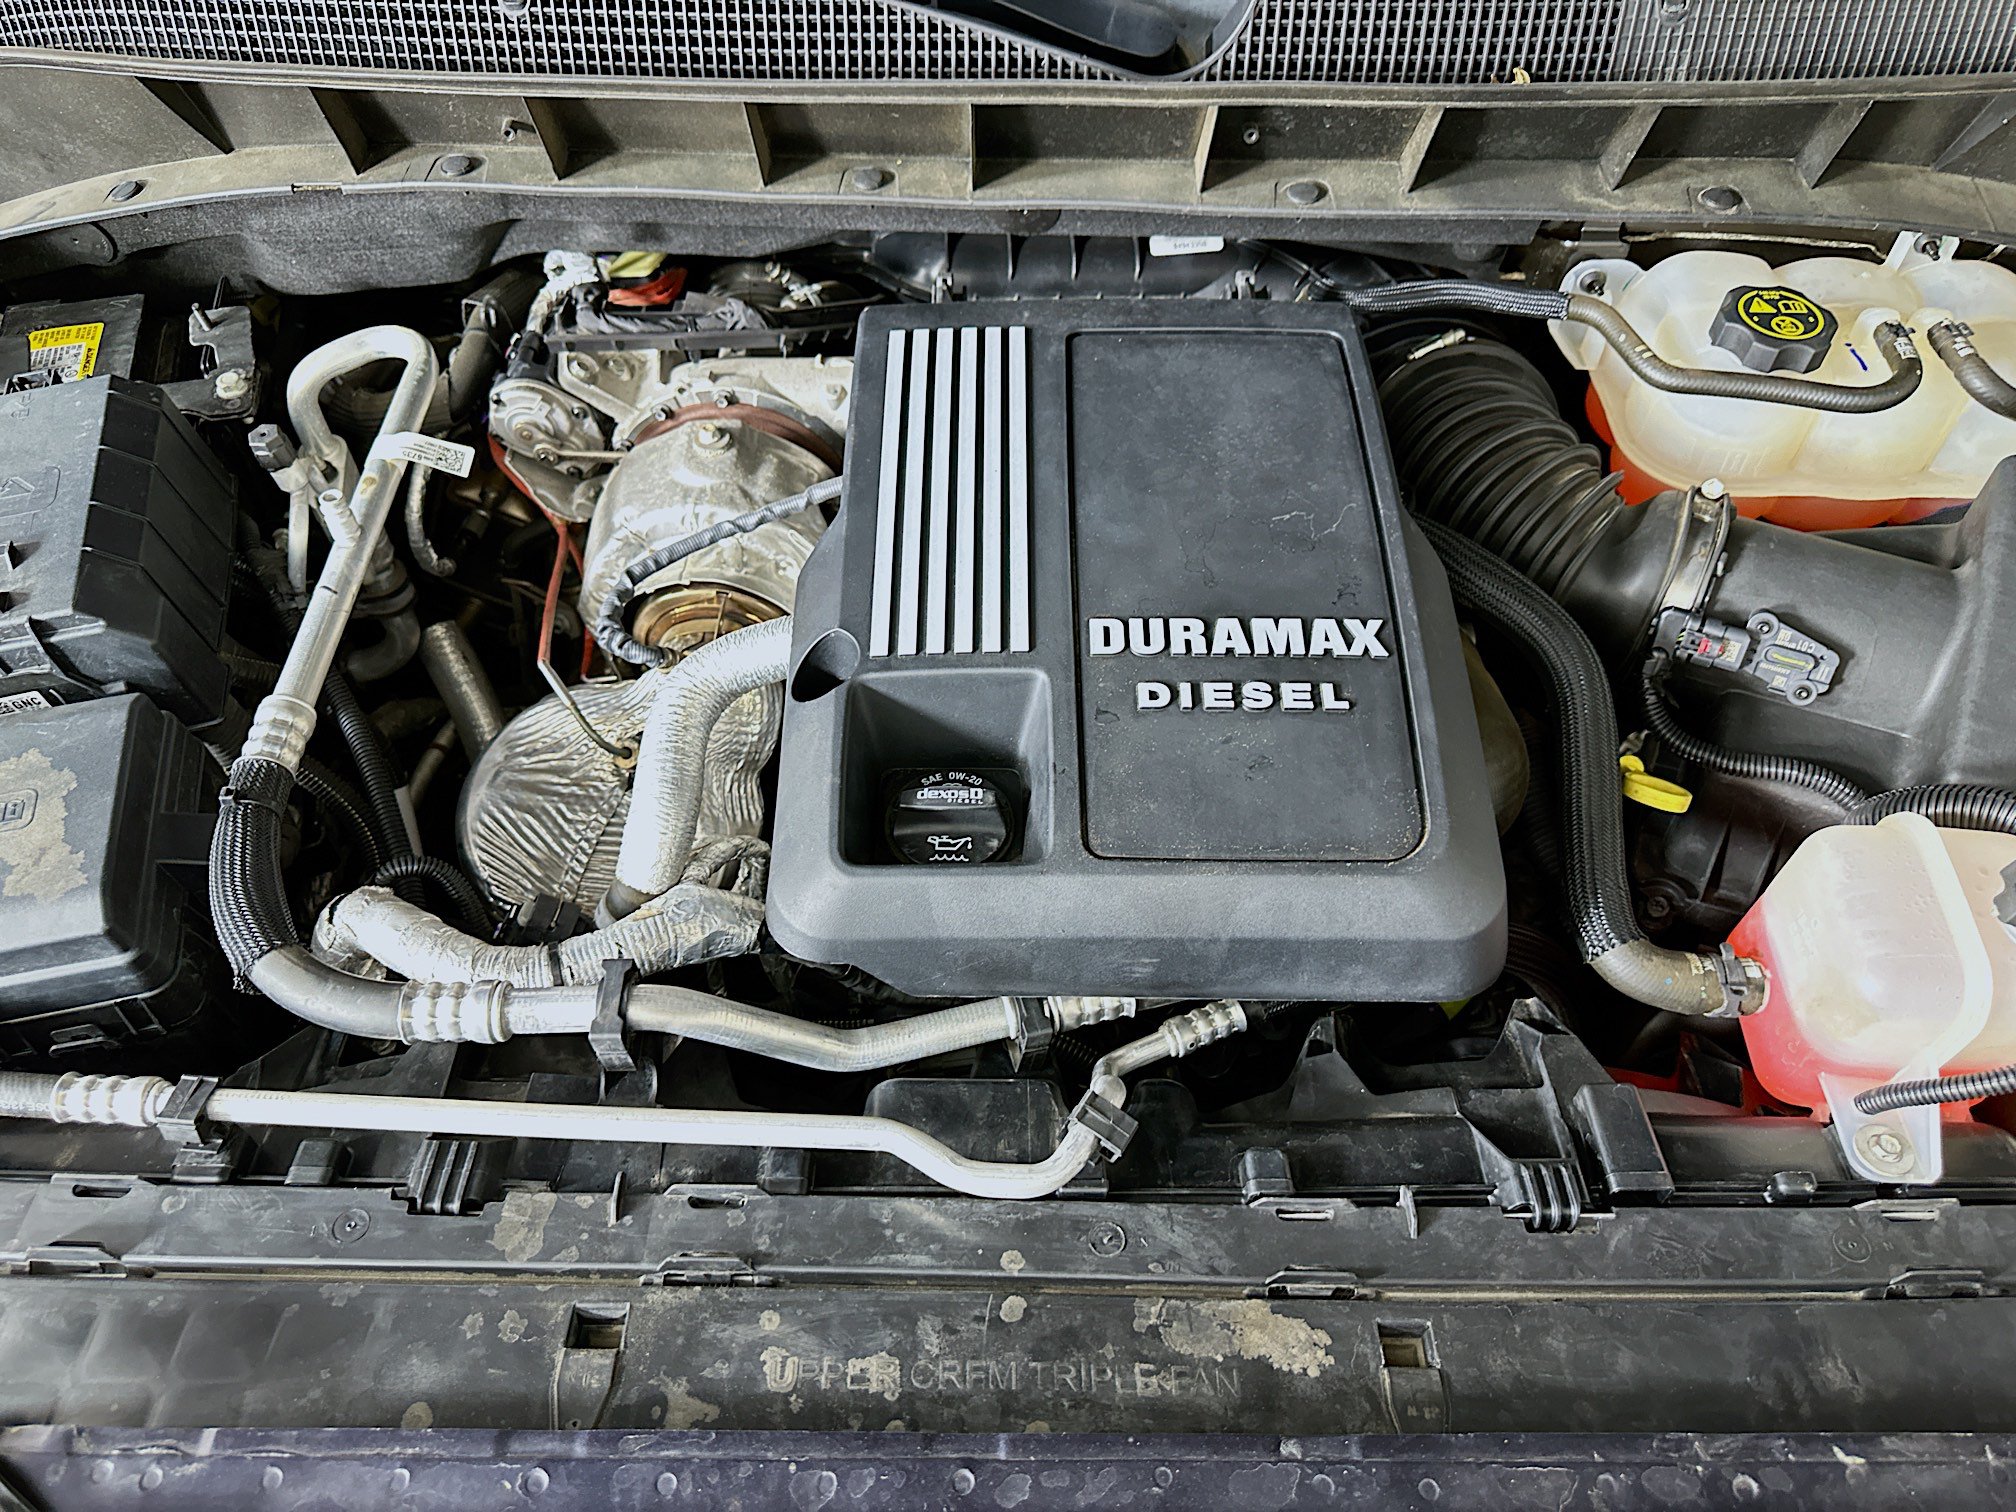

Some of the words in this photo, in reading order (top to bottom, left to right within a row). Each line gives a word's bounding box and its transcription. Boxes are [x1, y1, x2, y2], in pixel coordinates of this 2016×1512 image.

[1089, 617, 1389, 658] DURAMAX
[1137, 681, 1350, 711] DIESEL
[921, 772, 943, 786] SAE
[948, 771, 982, 786] 0W-20
[766, 1354, 901, 1392] UPPER
[1029, 1360, 1161, 1397] TRIPLE
[1171, 1364, 1241, 1398] FAN
